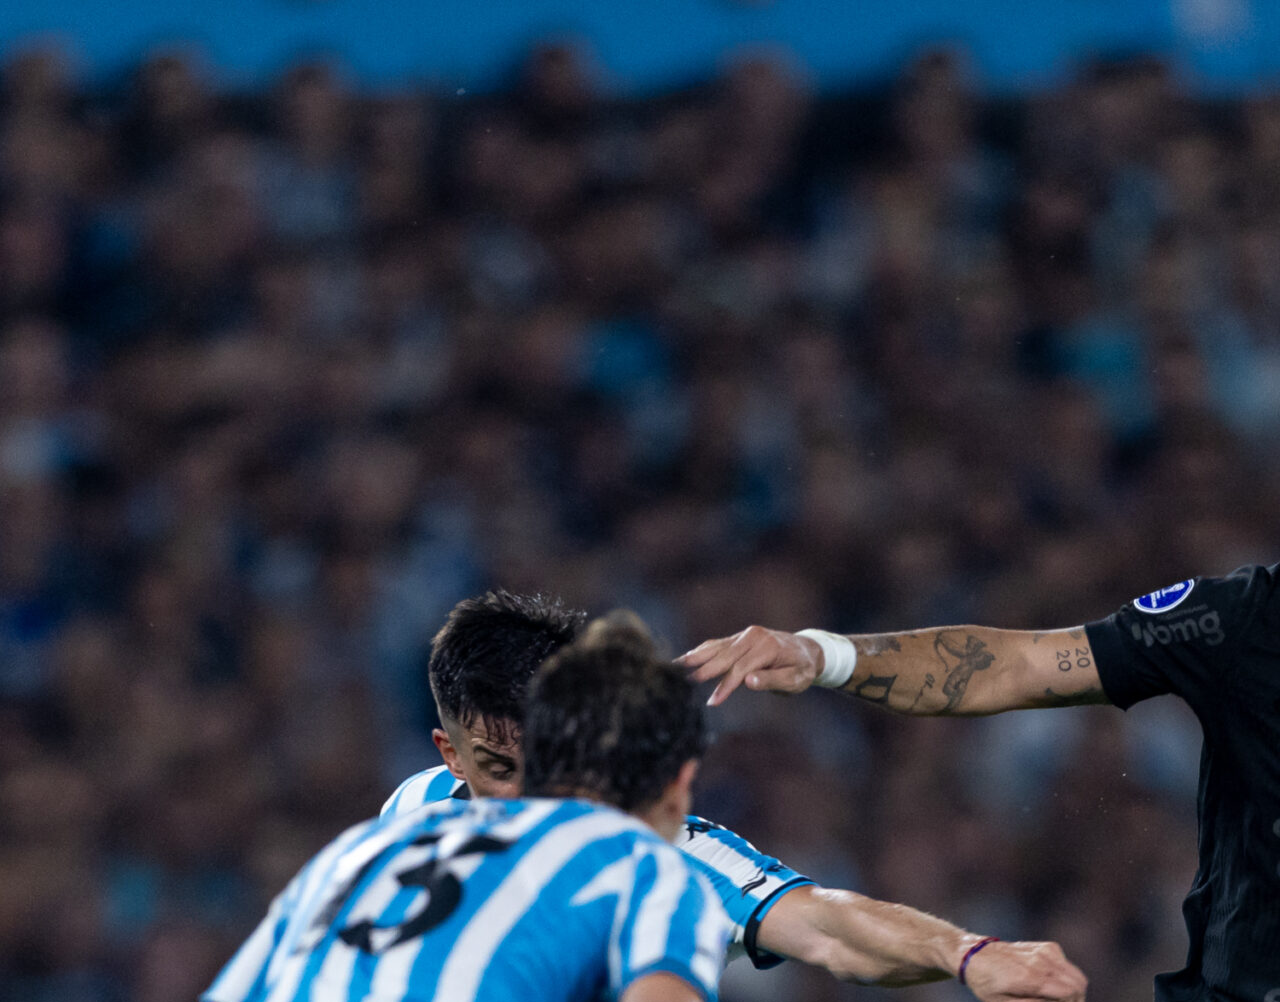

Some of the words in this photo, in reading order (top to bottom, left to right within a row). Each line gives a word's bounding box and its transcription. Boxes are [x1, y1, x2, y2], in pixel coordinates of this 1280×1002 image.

[1146, 610, 1226, 646] bmg
[1056, 649, 1072, 672] 20
[1075, 646, 1091, 668] 20
